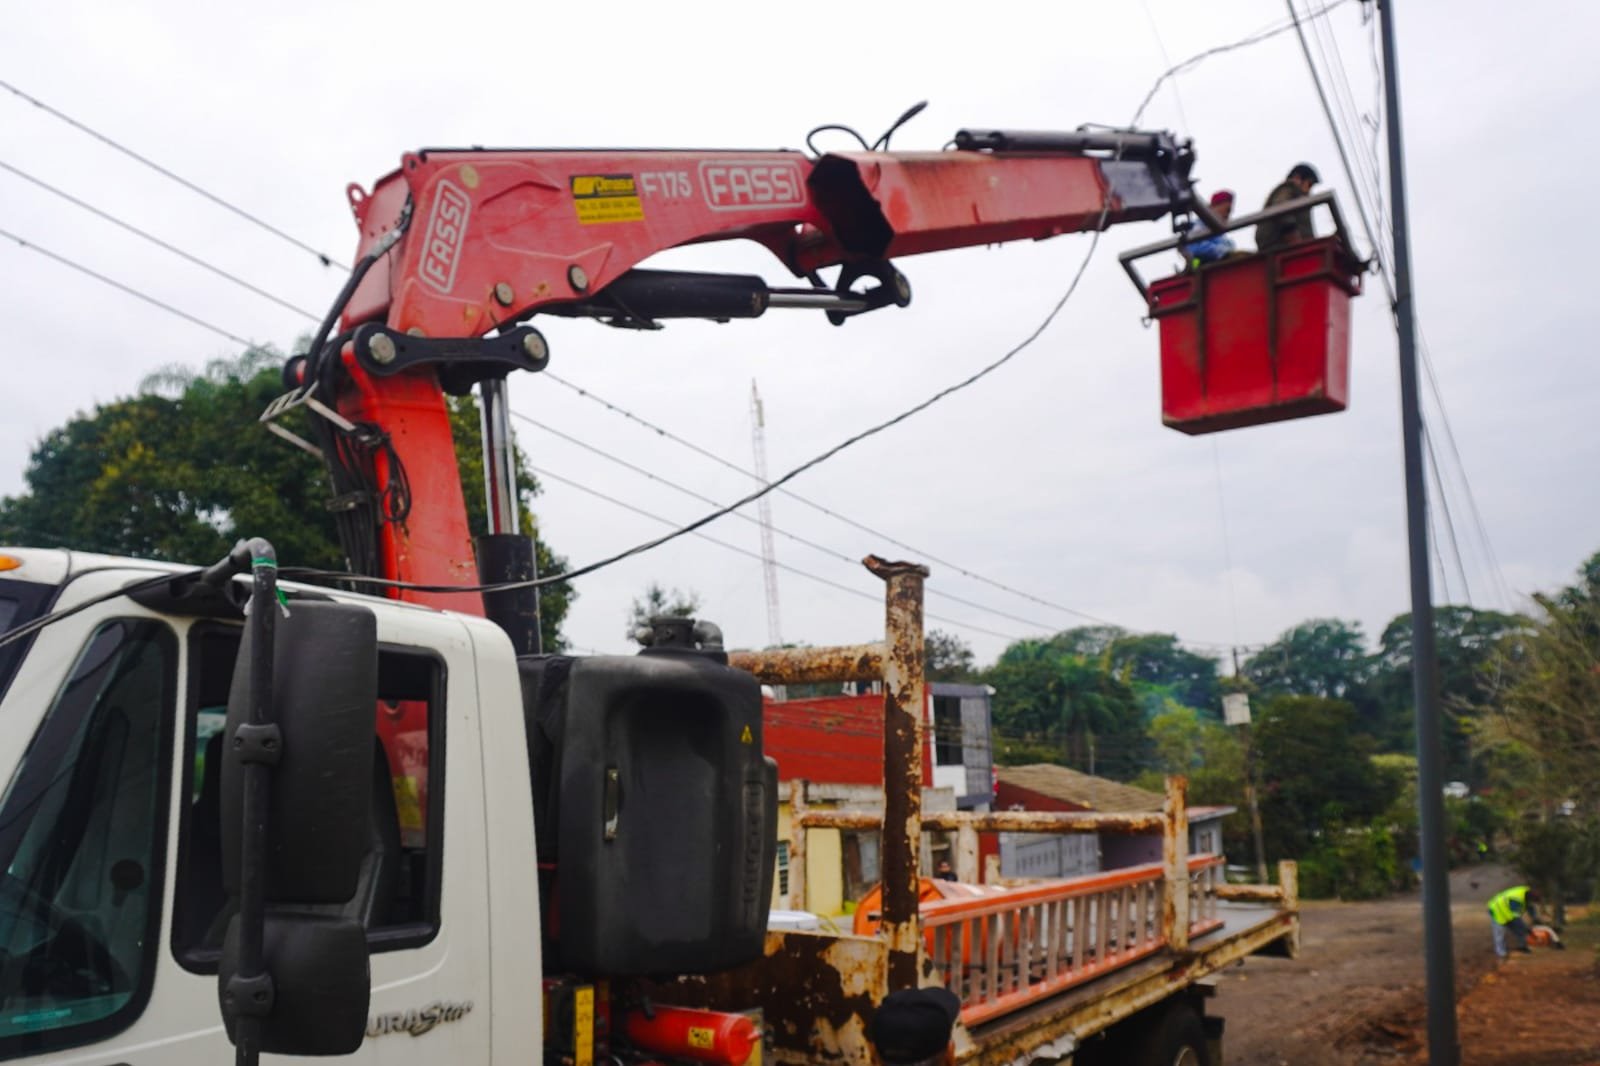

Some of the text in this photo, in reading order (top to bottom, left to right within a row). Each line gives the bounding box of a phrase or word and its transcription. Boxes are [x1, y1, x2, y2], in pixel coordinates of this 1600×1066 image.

[640, 171, 693, 199] F175
[707, 167, 801, 203] FASSI
[426, 190, 465, 283] FASSI
